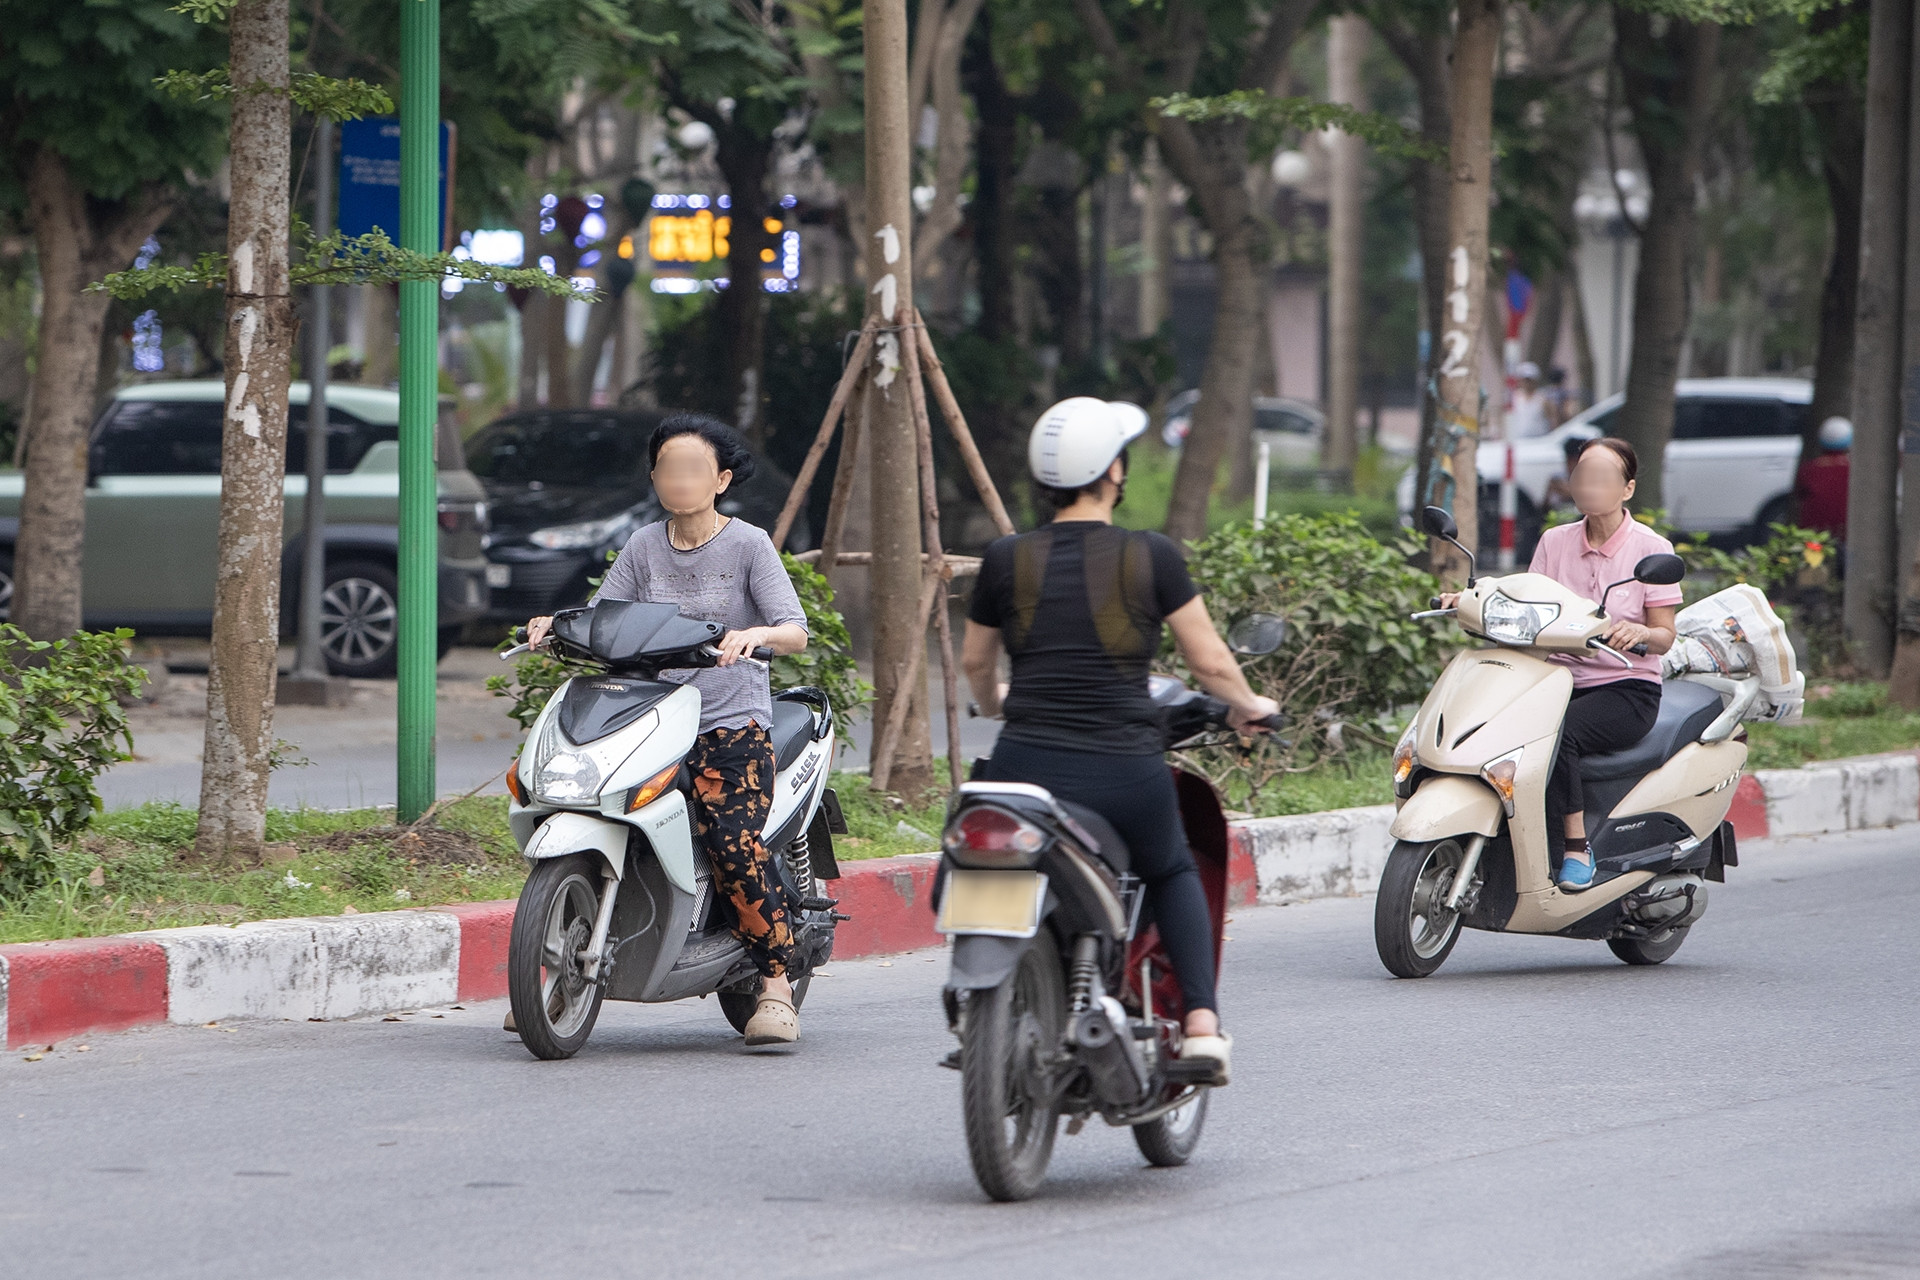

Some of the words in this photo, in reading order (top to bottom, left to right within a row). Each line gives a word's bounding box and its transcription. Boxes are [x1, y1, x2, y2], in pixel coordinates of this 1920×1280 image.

[872, 223, 900, 389] 113
[1440, 245, 1469, 377] 112
[790, 751, 817, 789] CLICK
[655, 808, 685, 830] HONDA
